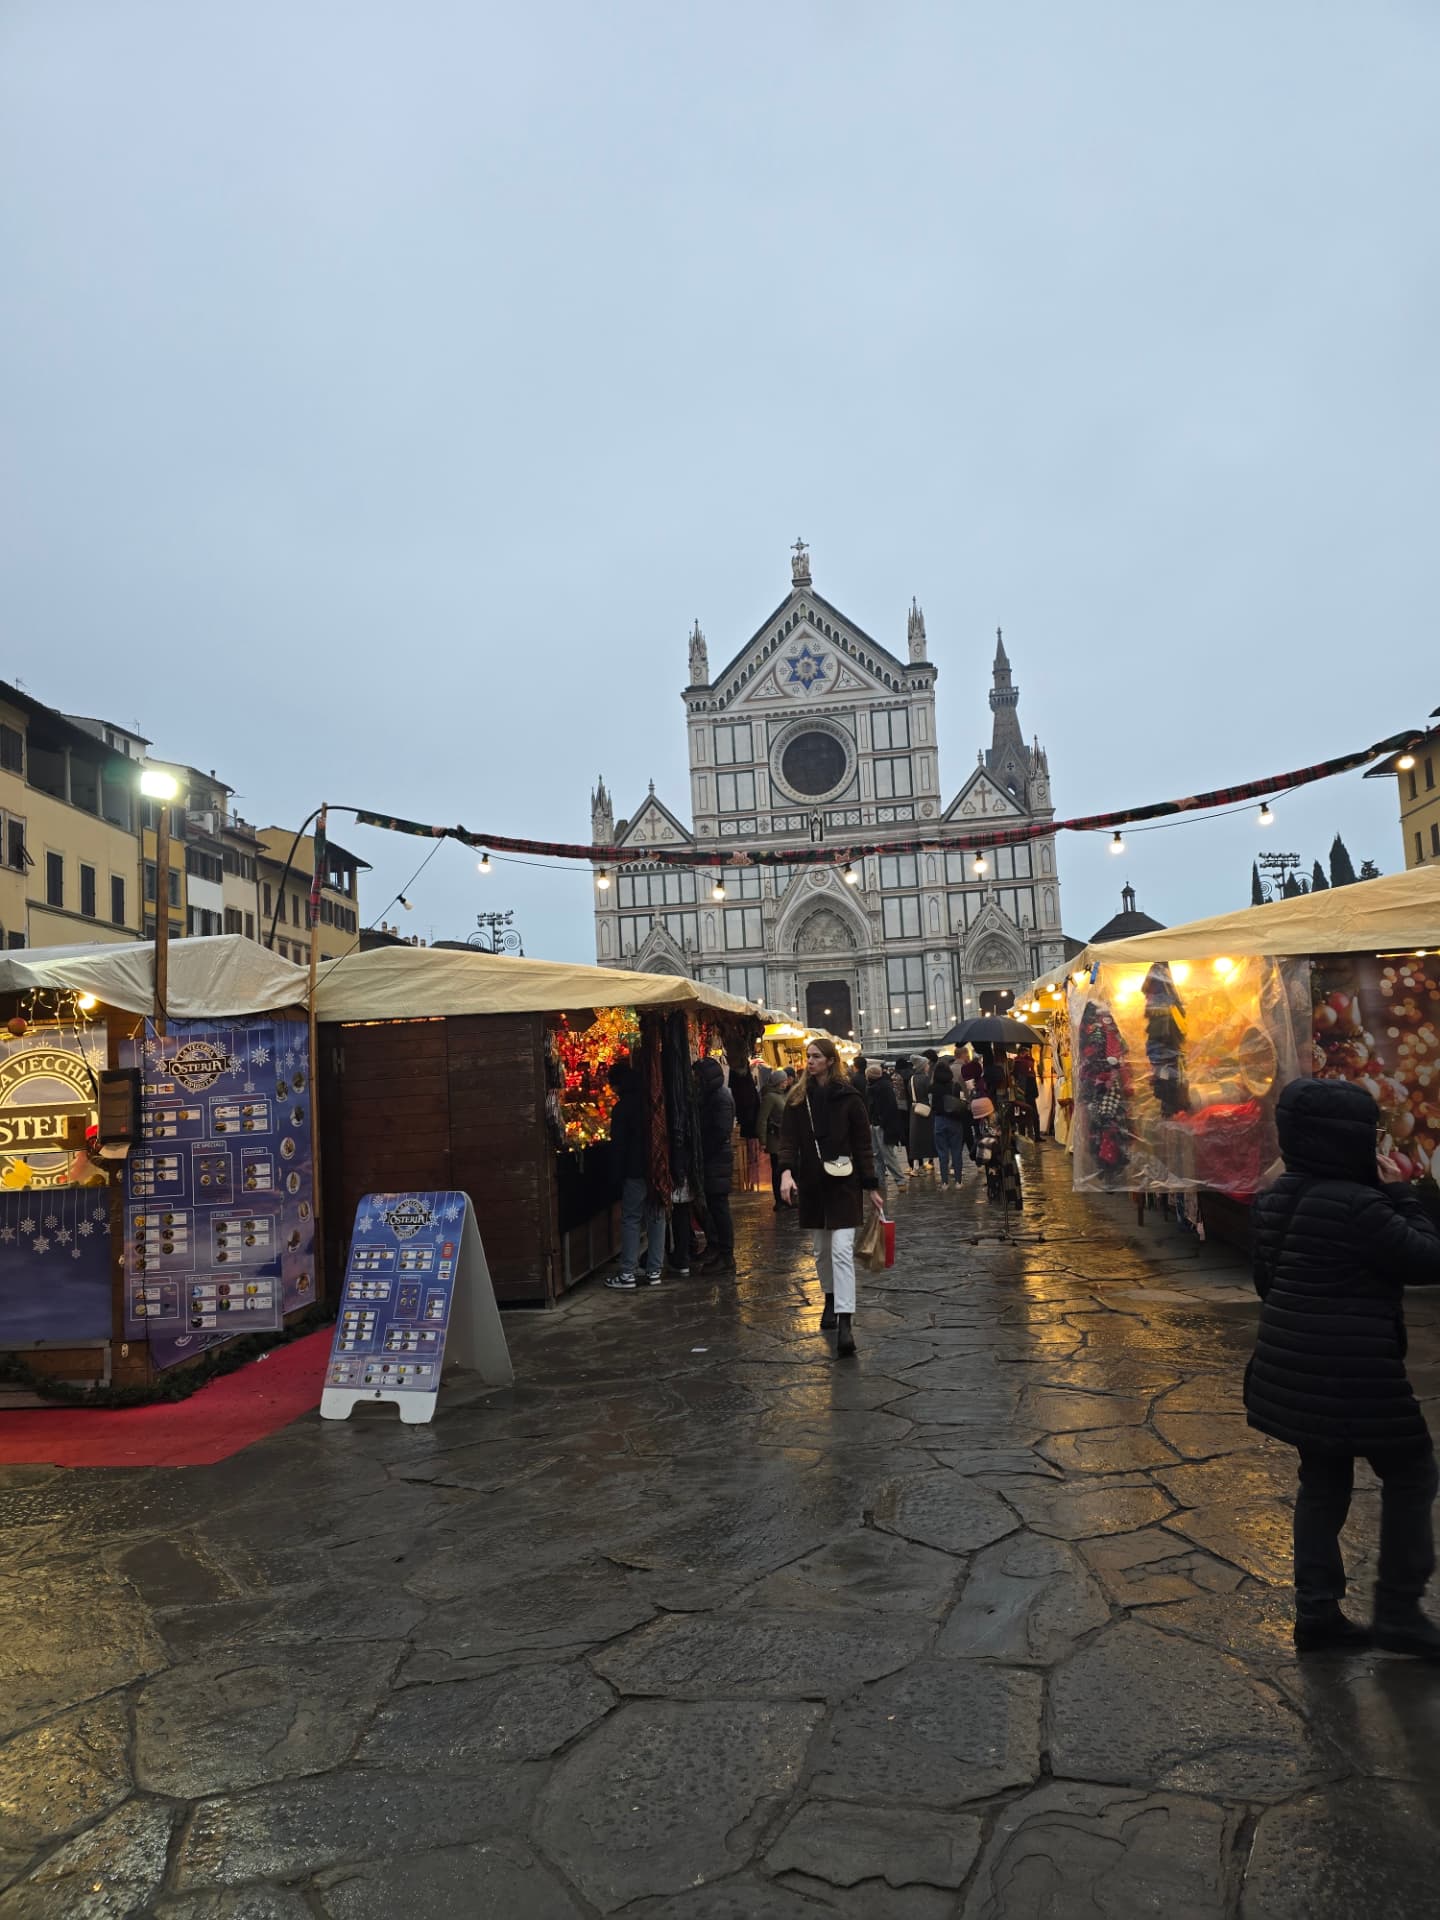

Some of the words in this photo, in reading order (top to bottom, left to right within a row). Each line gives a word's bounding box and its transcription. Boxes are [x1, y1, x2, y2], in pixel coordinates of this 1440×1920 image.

[14, 1056, 93, 1093] VECCHIA
[171, 1060, 225, 1075] OSTERIA
[389, 1214, 426, 1226] OSTERIA
